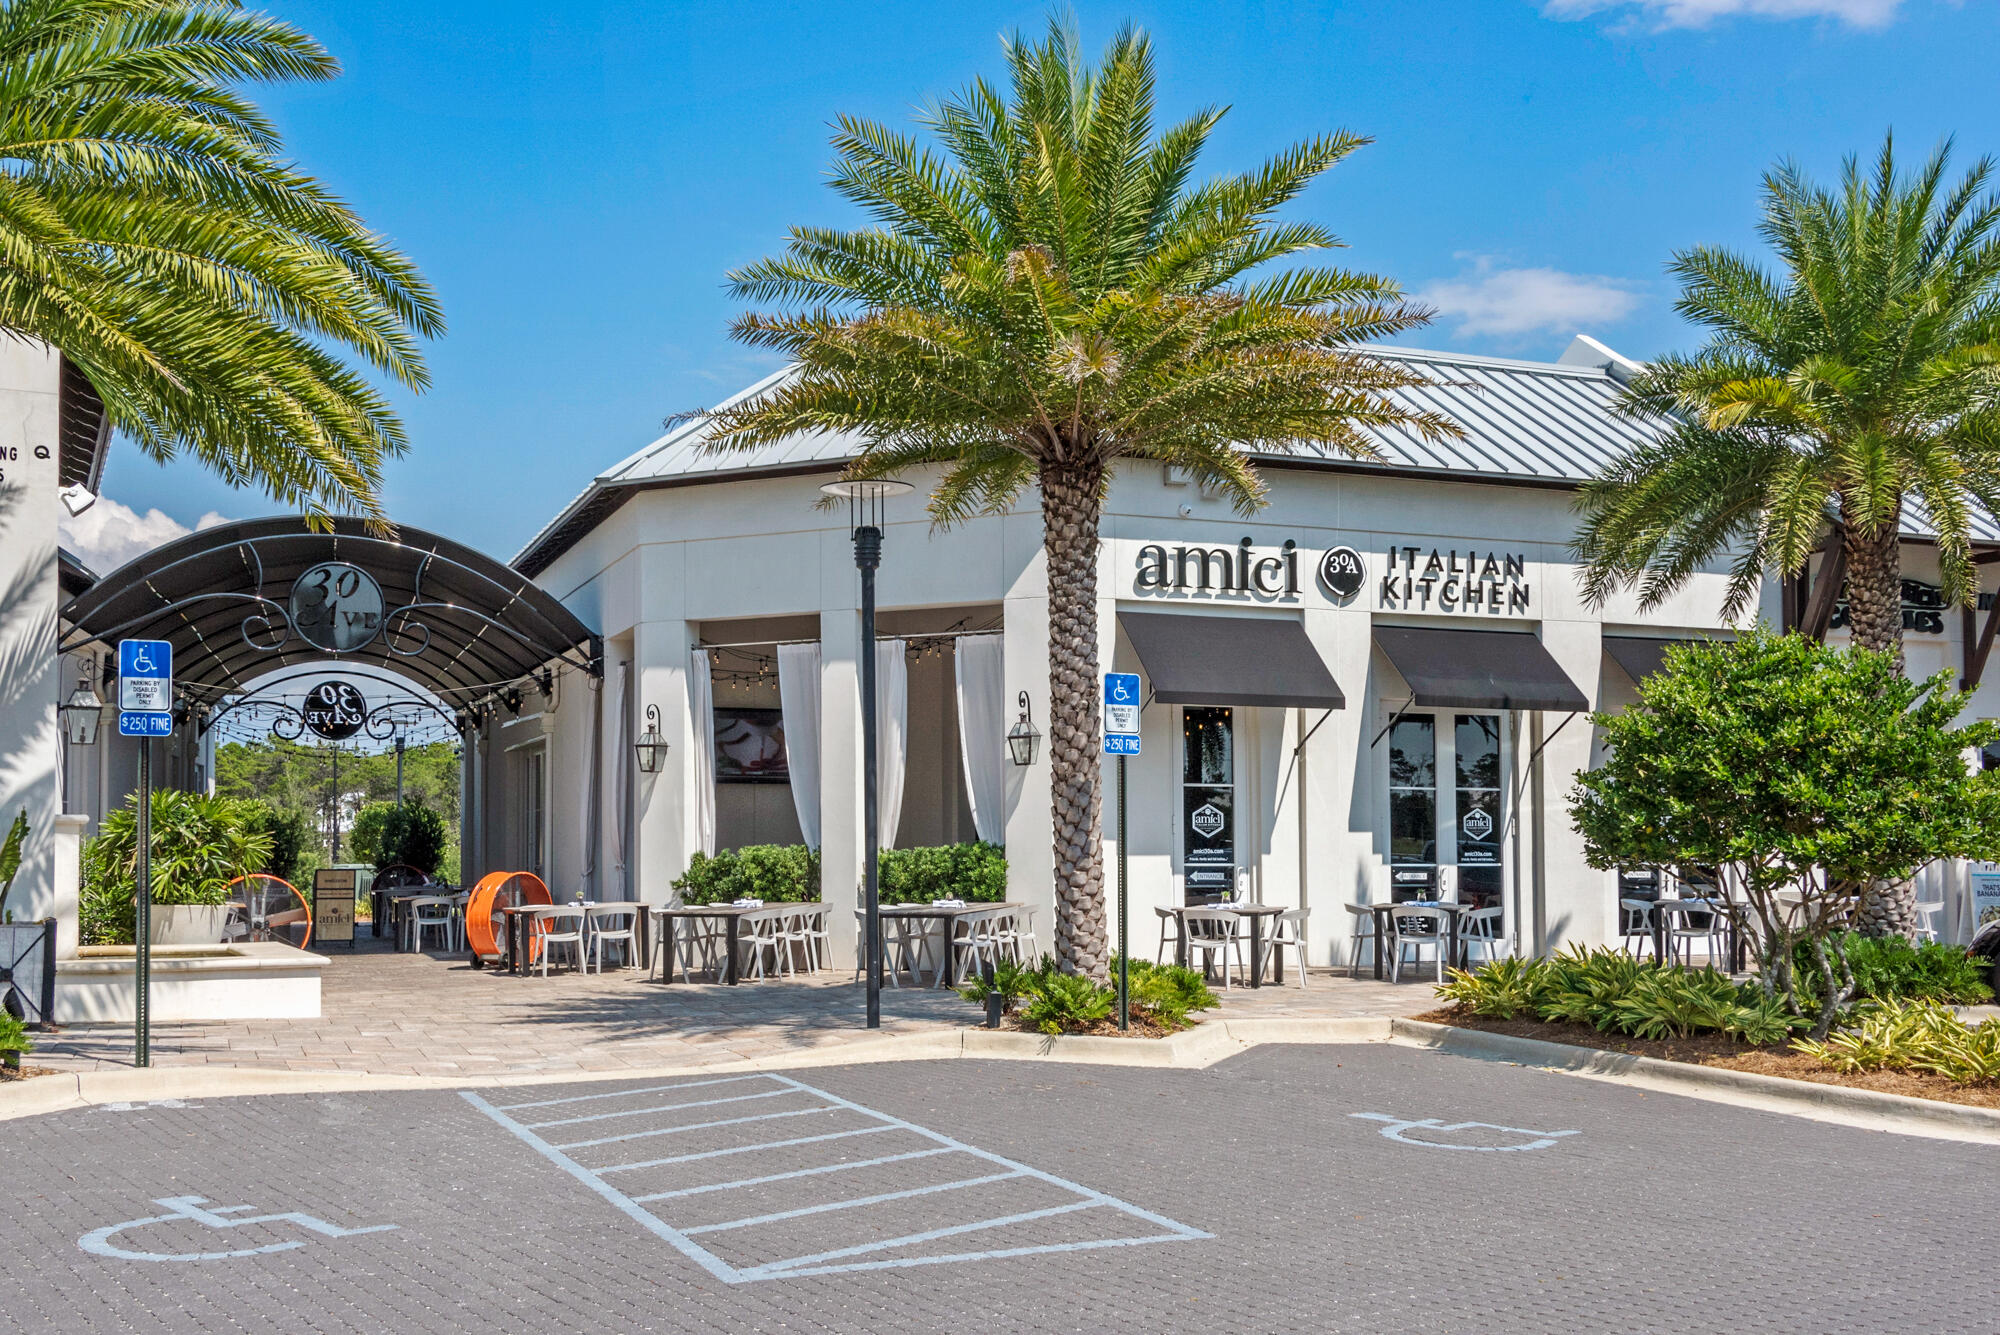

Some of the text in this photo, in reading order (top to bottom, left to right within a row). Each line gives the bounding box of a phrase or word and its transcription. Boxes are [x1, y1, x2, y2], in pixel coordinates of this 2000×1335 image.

[1137, 536, 1303, 594] amici
[1329, 553, 1359, 575] 30A
[1389, 545, 1524, 578] ITALIAN
[305, 568, 360, 608] 30
[1383, 575, 1530, 607] KITCHEN
[151, 717, 169, 730] FINE
[1125, 738, 1139, 751] FINE
[1195, 814, 1220, 823] amici
